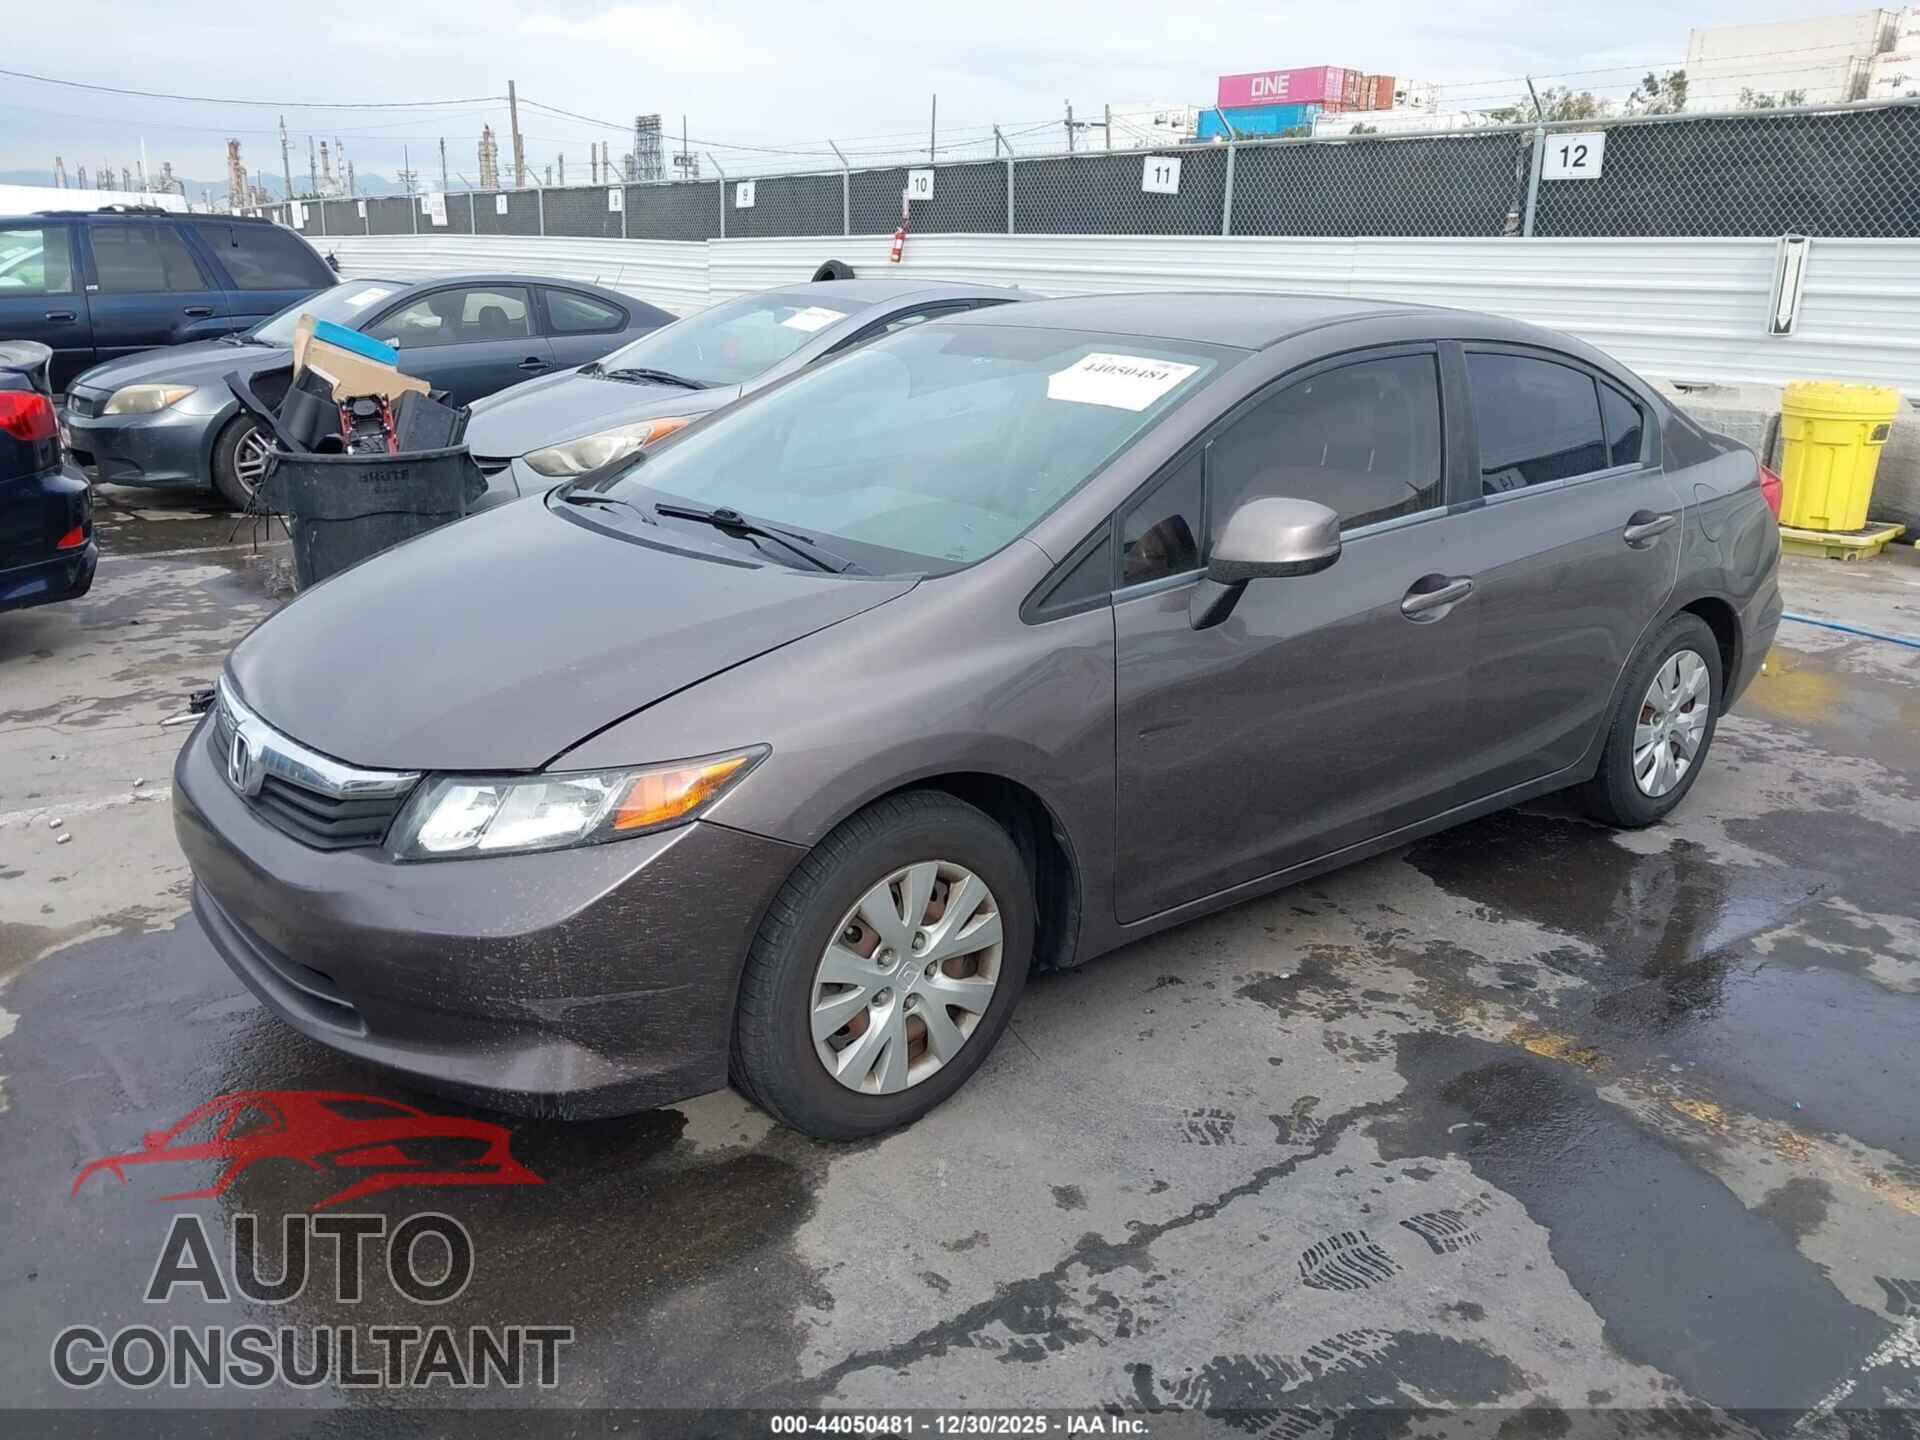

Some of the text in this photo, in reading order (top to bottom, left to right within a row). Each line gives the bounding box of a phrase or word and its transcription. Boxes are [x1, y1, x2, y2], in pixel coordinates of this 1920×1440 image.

[1251, 75, 1290, 97] ONE
[1560, 144, 1588, 168] 12
[1155, 166, 1170, 184] 11
[914, 177, 928, 192] 10
[1083, 363, 1169, 380] 44050481
